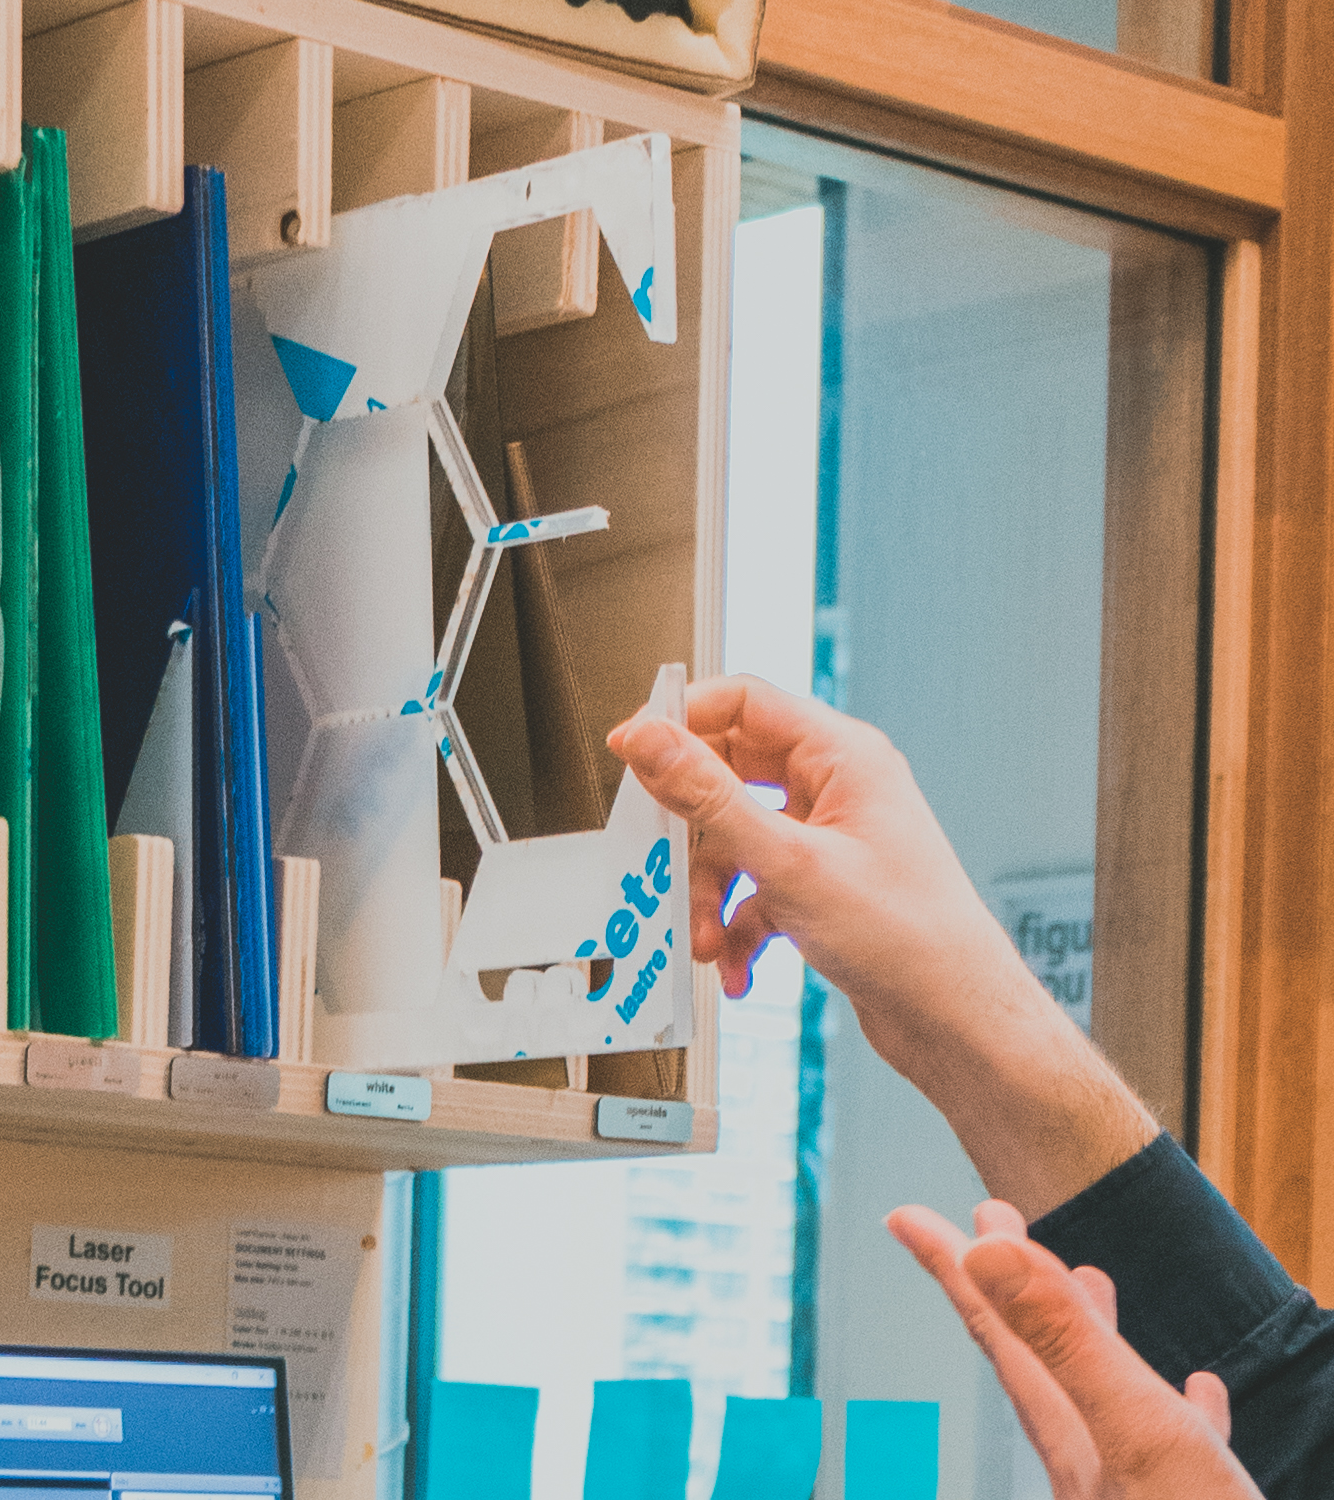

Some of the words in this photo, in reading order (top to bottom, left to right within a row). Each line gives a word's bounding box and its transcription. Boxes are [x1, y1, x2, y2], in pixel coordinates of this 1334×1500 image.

[616, 950, 667, 1024] lastre
[366, 1080, 395, 1094] white
[626, 1105, 668, 1119] specials
[68, 1233, 136, 1263] Laser
[34, 1264, 109, 1295] Focus
[115, 1271, 165, 1300] Tool
